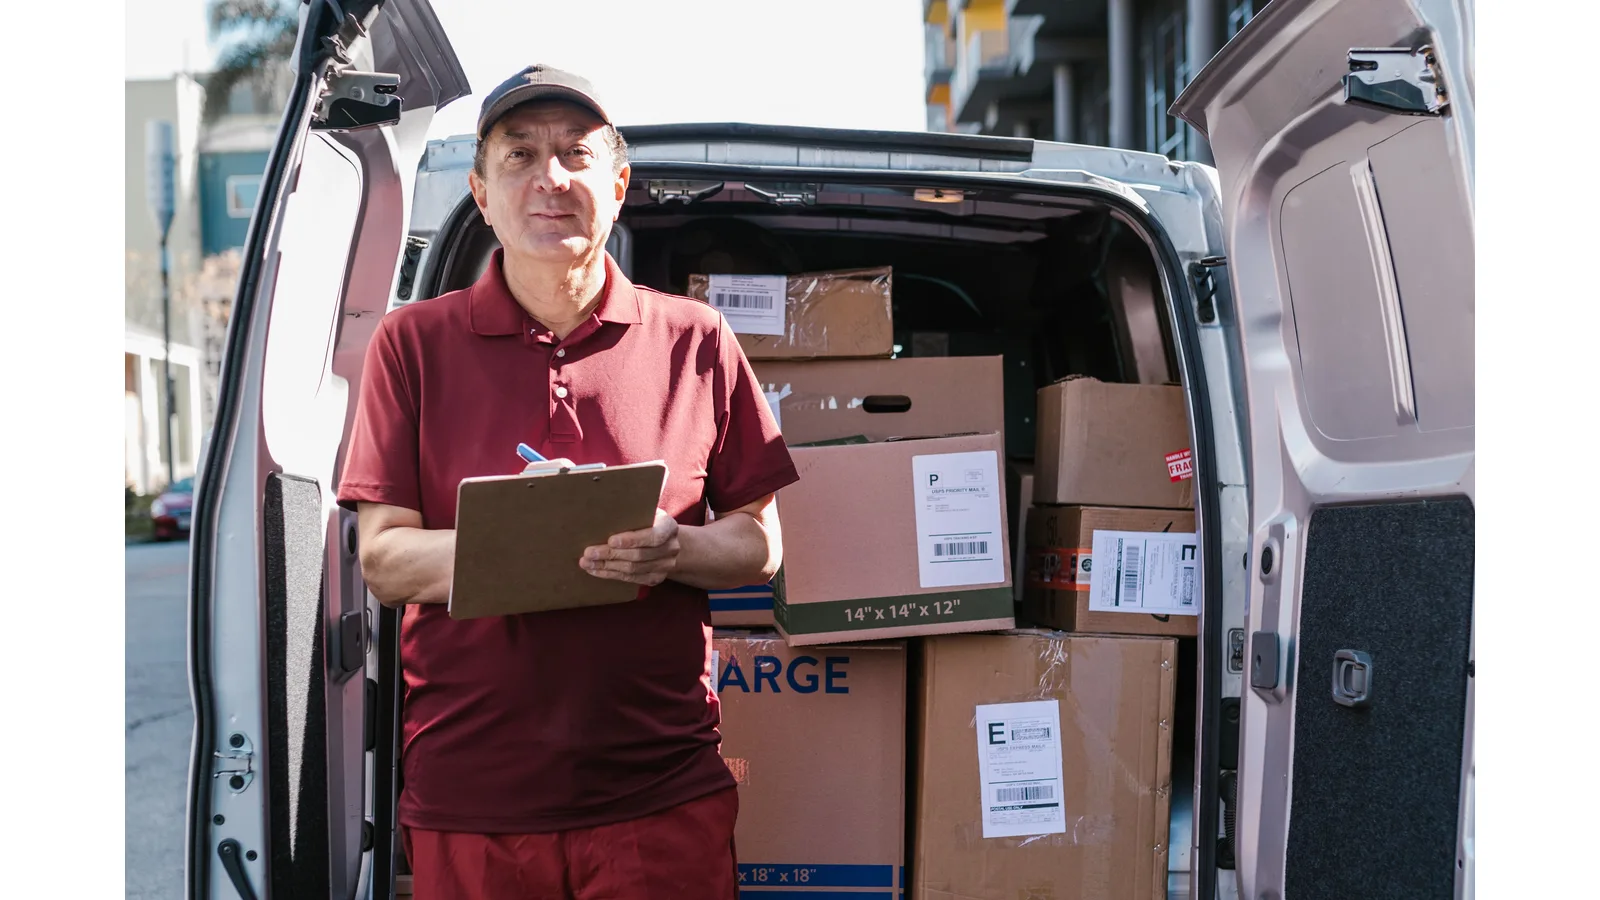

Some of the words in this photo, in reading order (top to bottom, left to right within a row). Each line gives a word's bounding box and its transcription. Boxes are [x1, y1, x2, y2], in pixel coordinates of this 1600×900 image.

[929, 474, 939, 486] P
[1181, 544, 1197, 561] E
[844, 606, 871, 622] 14"
[874, 609, 885, 620] x
[889, 603, 916, 618] 14"
[919, 605, 929, 616] x
[933, 599, 961, 615] 12"
[718, 655, 850, 694] ARGE
[988, 722, 1006, 745] E
[738, 872, 746, 882] x
[752, 868, 776, 882] 18"
[779, 873, 788, 882] x
[793, 868, 817, 882] 18"
